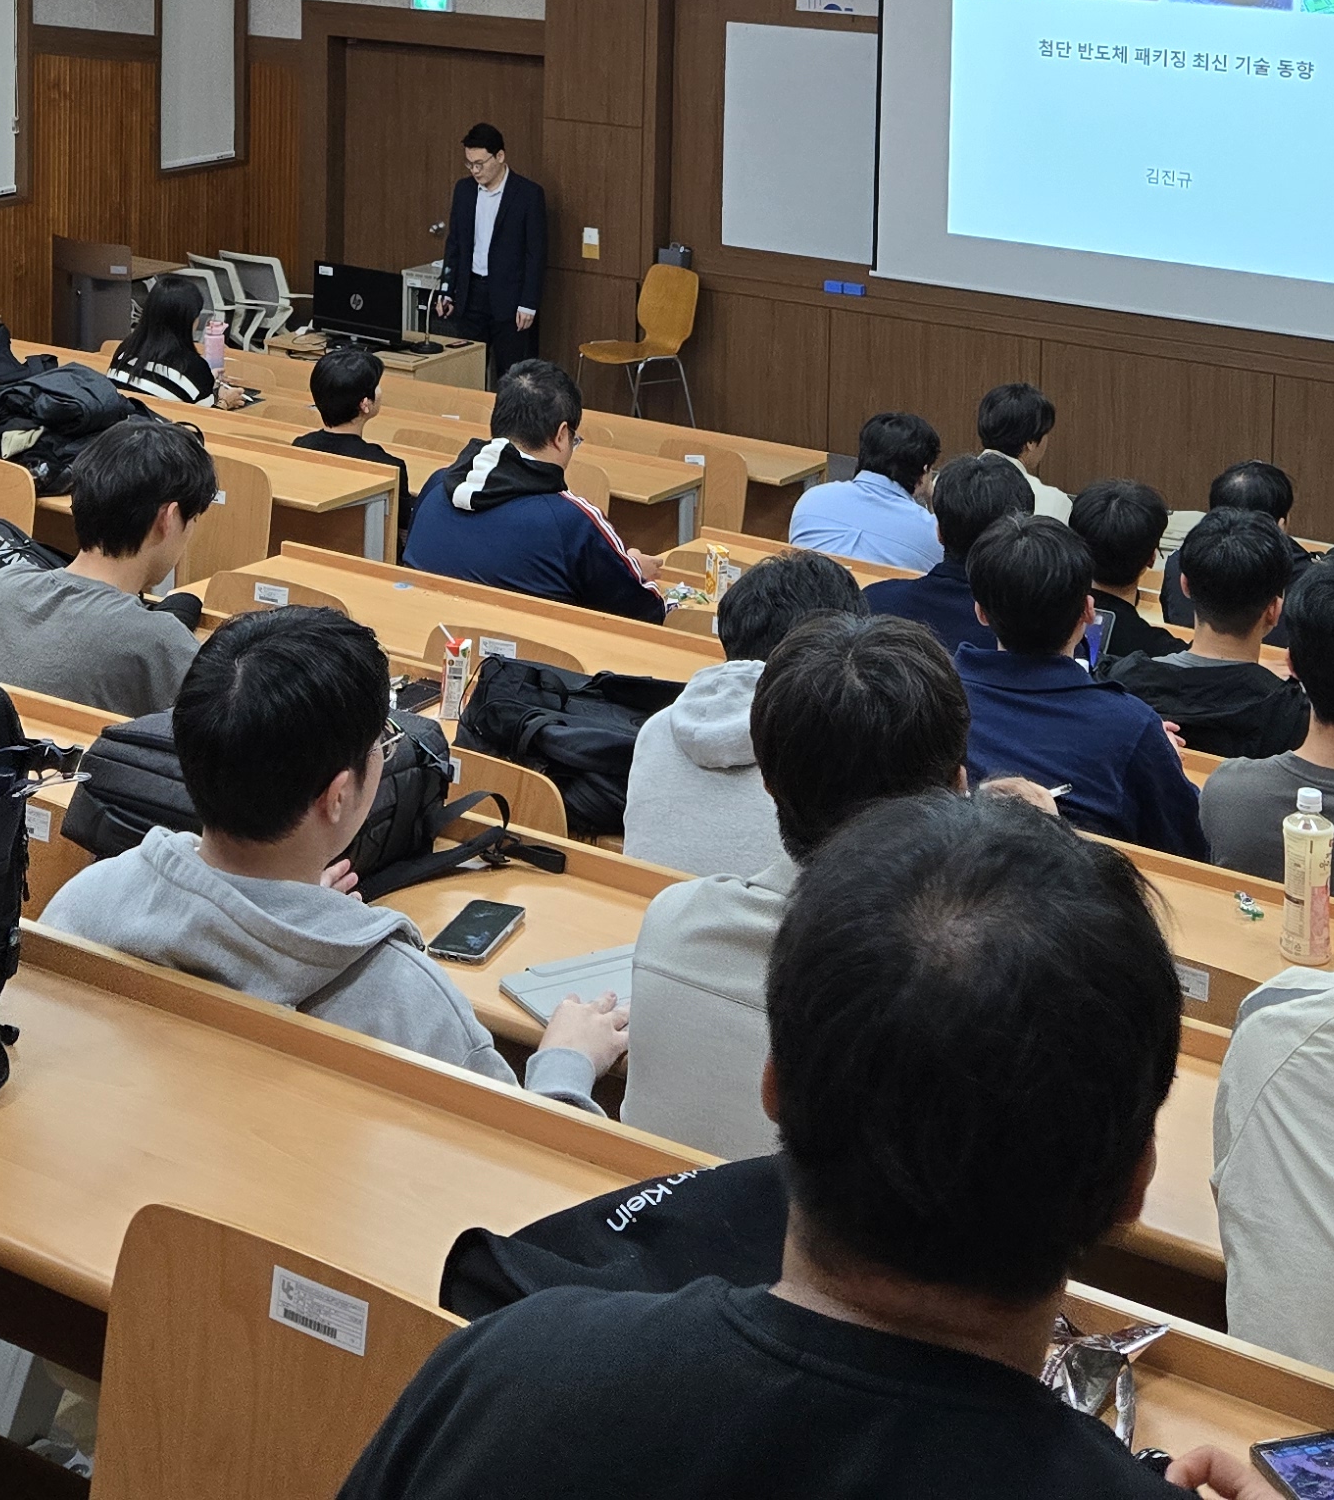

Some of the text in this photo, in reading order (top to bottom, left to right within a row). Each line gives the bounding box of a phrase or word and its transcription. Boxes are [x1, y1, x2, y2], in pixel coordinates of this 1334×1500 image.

[1038, 39, 1315, 80] 첨단 반도체 패키징 최신 기술 동향
[1146, 168, 1192, 189] 김진규
[606, 1183, 673, 1232] Klein
